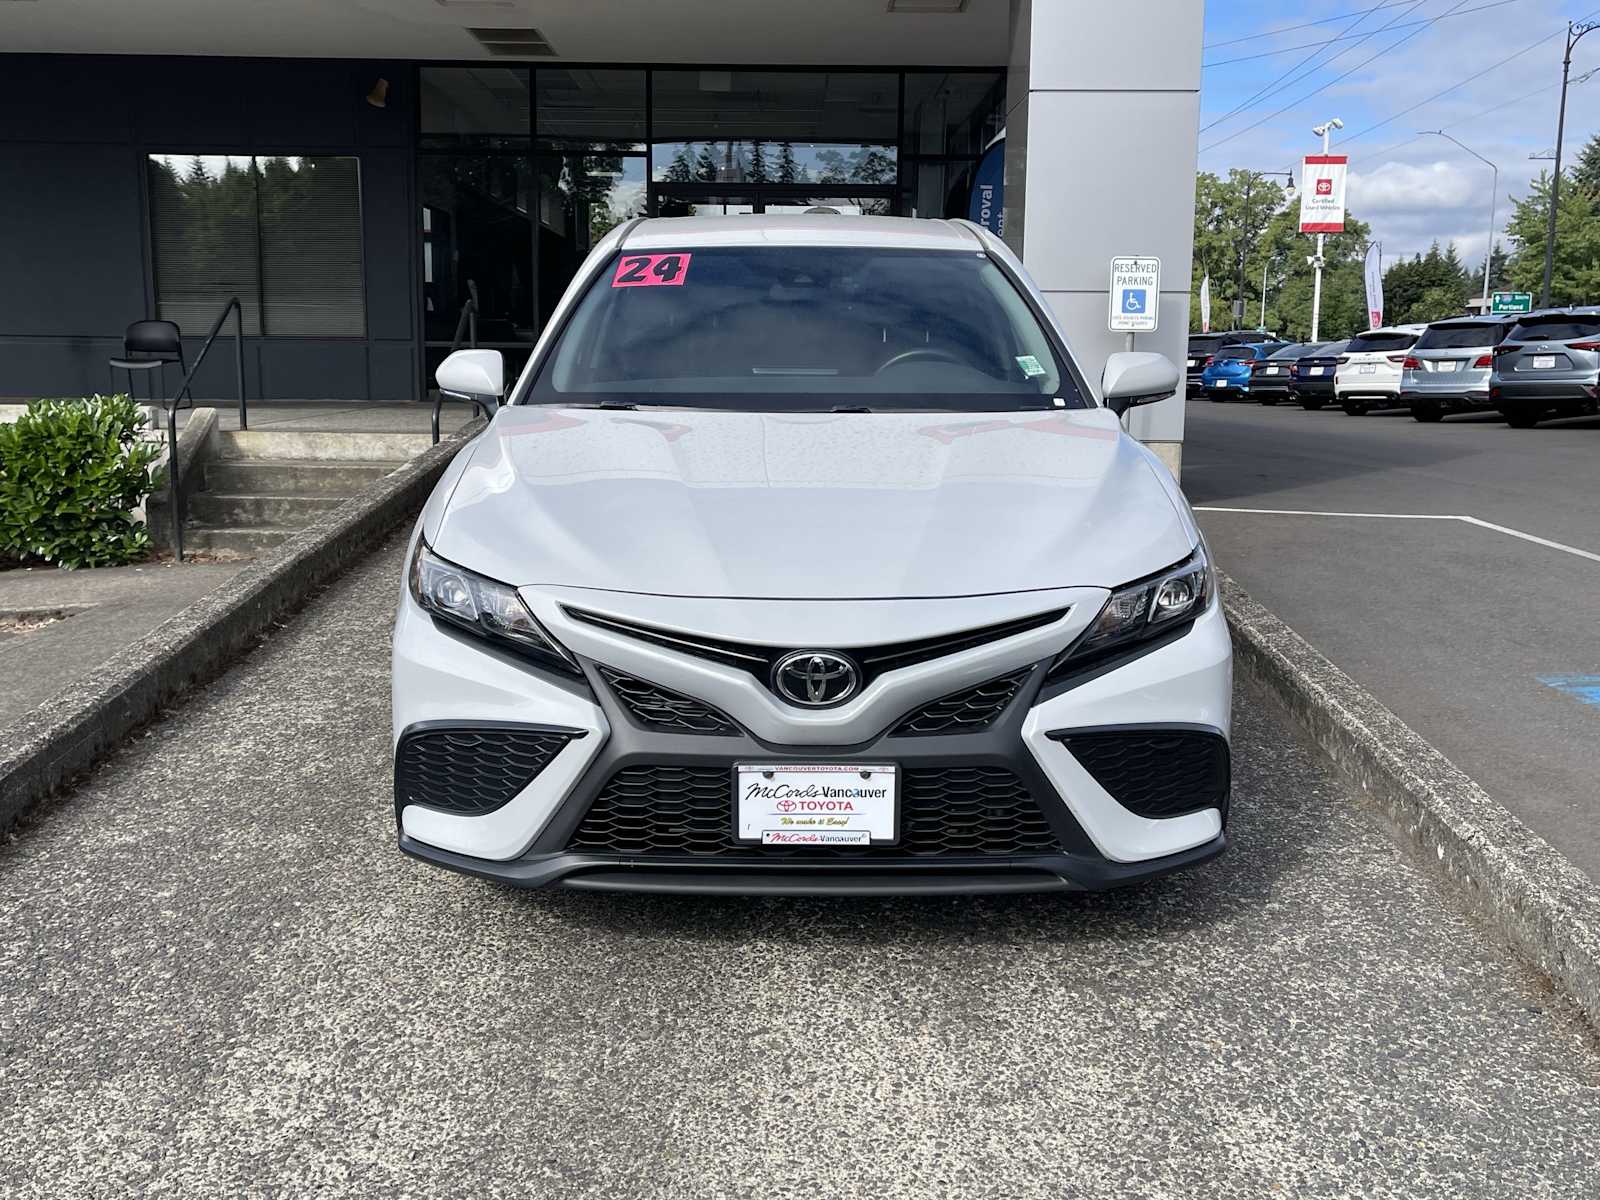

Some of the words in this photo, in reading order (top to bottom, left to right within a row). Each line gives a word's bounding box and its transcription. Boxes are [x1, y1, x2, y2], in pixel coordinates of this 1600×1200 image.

[617, 256, 682, 282] 24
[1114, 263, 1157, 274] RESERVED
[1116, 275, 1153, 286] PARKING
[800, 801, 854, 811] TOYOTA
